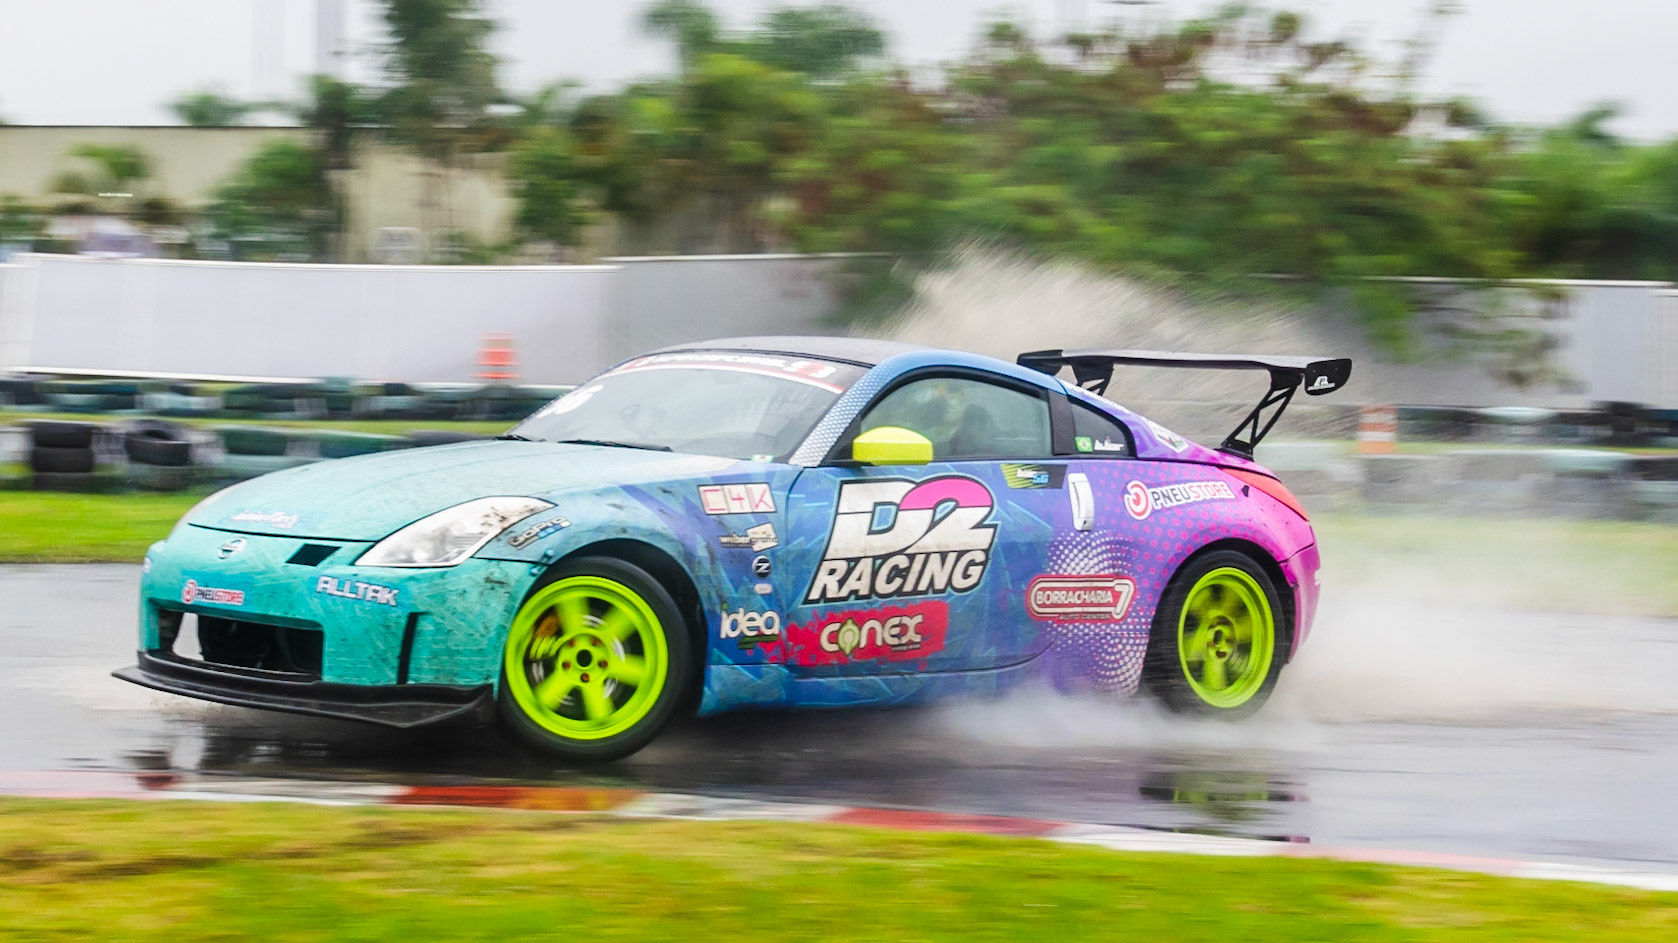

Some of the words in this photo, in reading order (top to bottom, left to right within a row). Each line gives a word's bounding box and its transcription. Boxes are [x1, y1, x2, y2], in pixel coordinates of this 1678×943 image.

[1149, 483, 1233, 508] PNEUSTORE
[824, 477, 996, 560] D2
[315, 575, 400, 607] ALLTAK
[807, 550, 988, 600] RACING
[1036, 590, 1113, 604] BORRACHARIA
[1112, 580, 1133, 618] 7
[720, 603, 780, 639] idea
